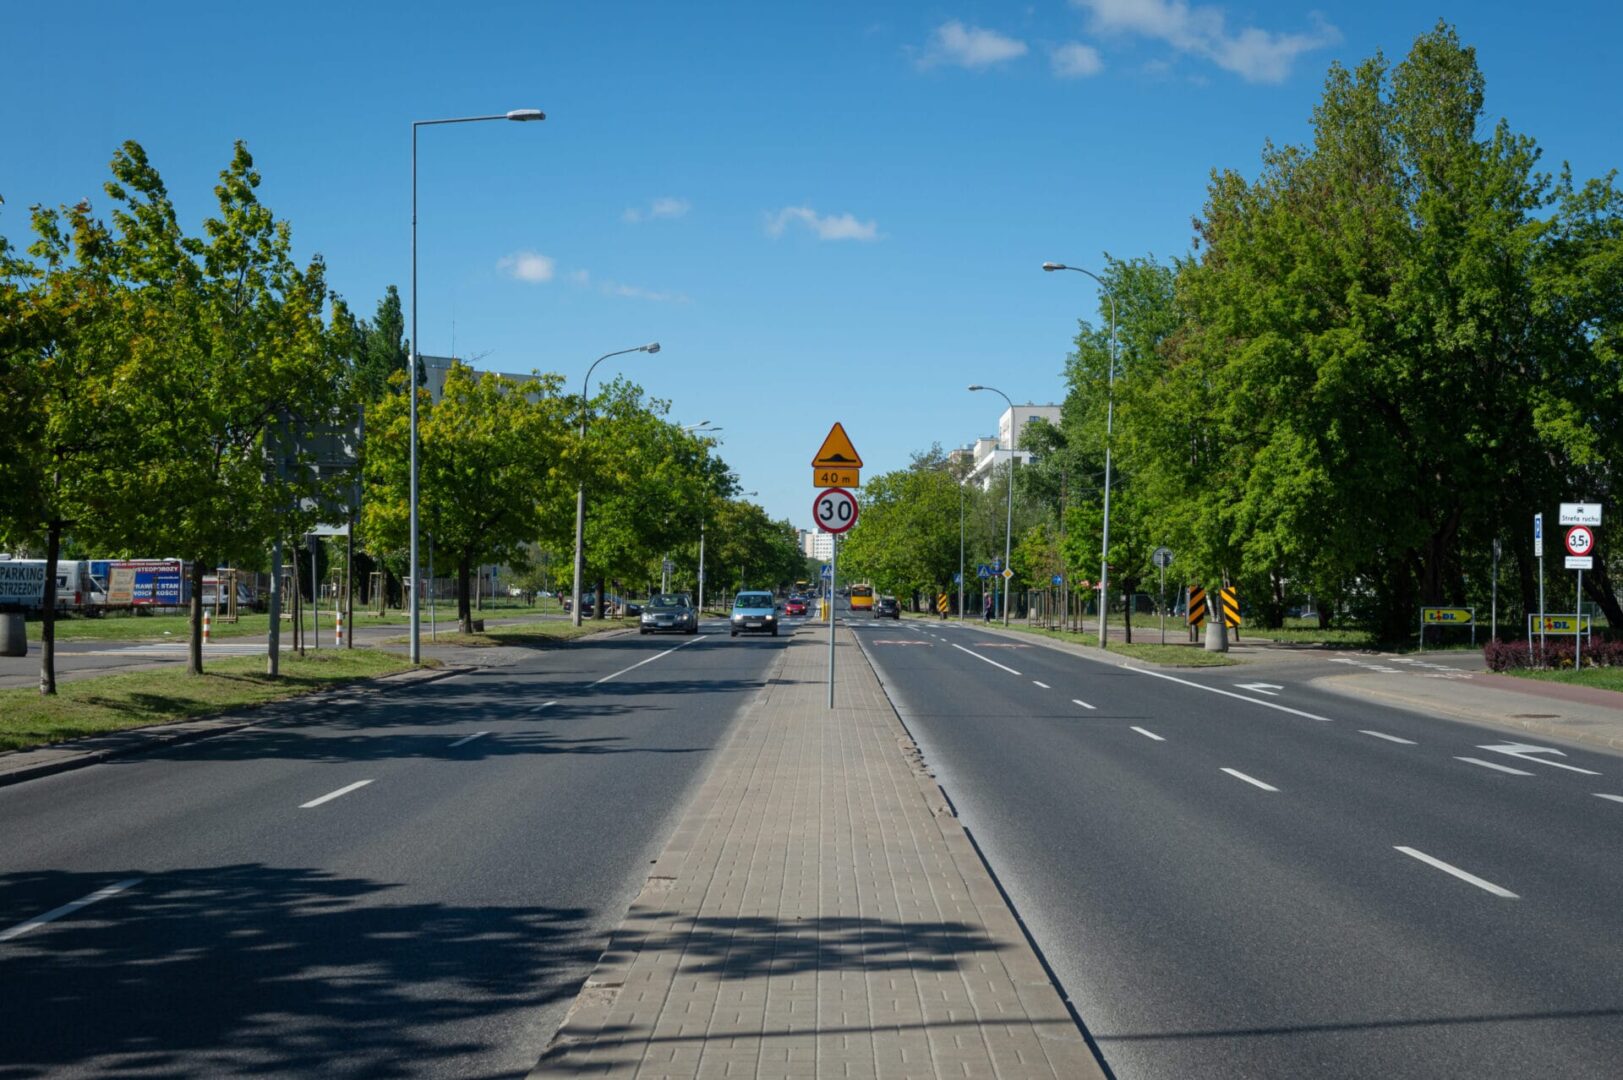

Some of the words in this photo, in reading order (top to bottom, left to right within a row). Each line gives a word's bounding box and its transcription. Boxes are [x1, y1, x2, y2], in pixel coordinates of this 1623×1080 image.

[821, 473, 838, 483] 40
[820, 500, 852, 521] 30
[1561, 514, 1580, 522] Strefa
[0, 567, 44, 580] PARKING
